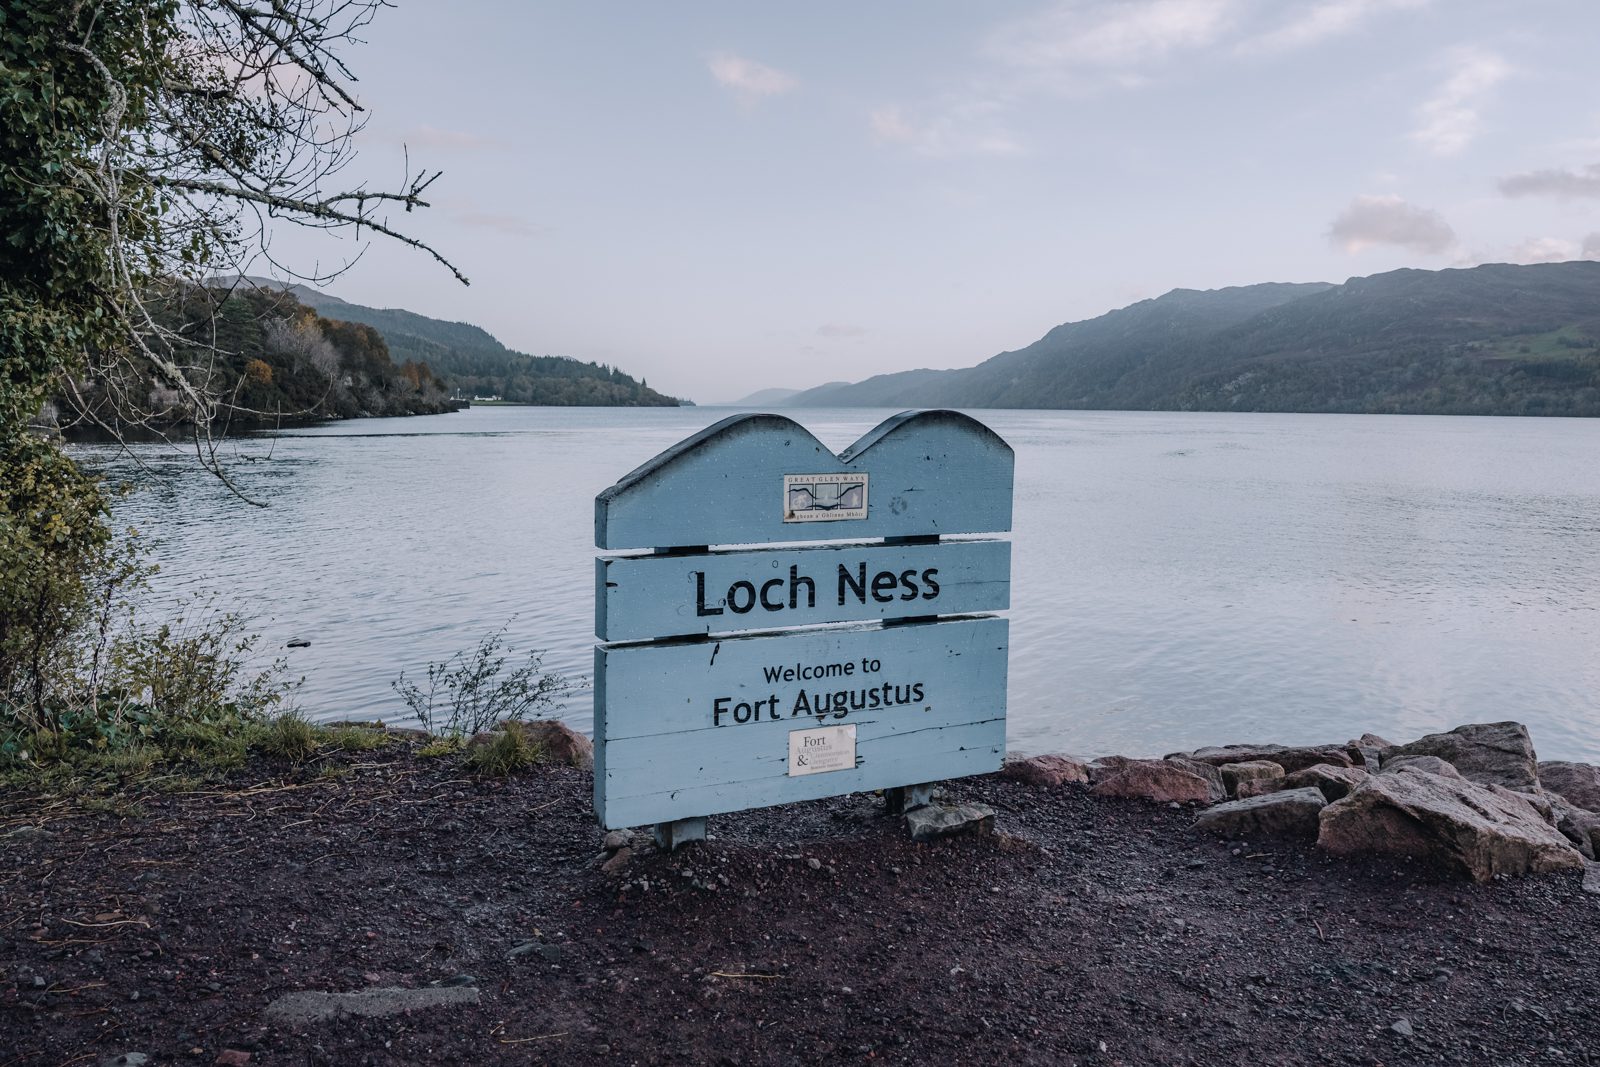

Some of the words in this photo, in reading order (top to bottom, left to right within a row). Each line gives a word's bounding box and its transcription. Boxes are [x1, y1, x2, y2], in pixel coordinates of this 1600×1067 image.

[696, 564, 816, 617] Loch
[838, 562, 940, 606] Ness
[763, 662, 855, 684] Welcome
[862, 657, 881, 673] to
[714, 694, 781, 726] Fort
[792, 682, 925, 719] Augustus
[803, 736, 826, 748] Fort
[797, 754, 809, 767] &
